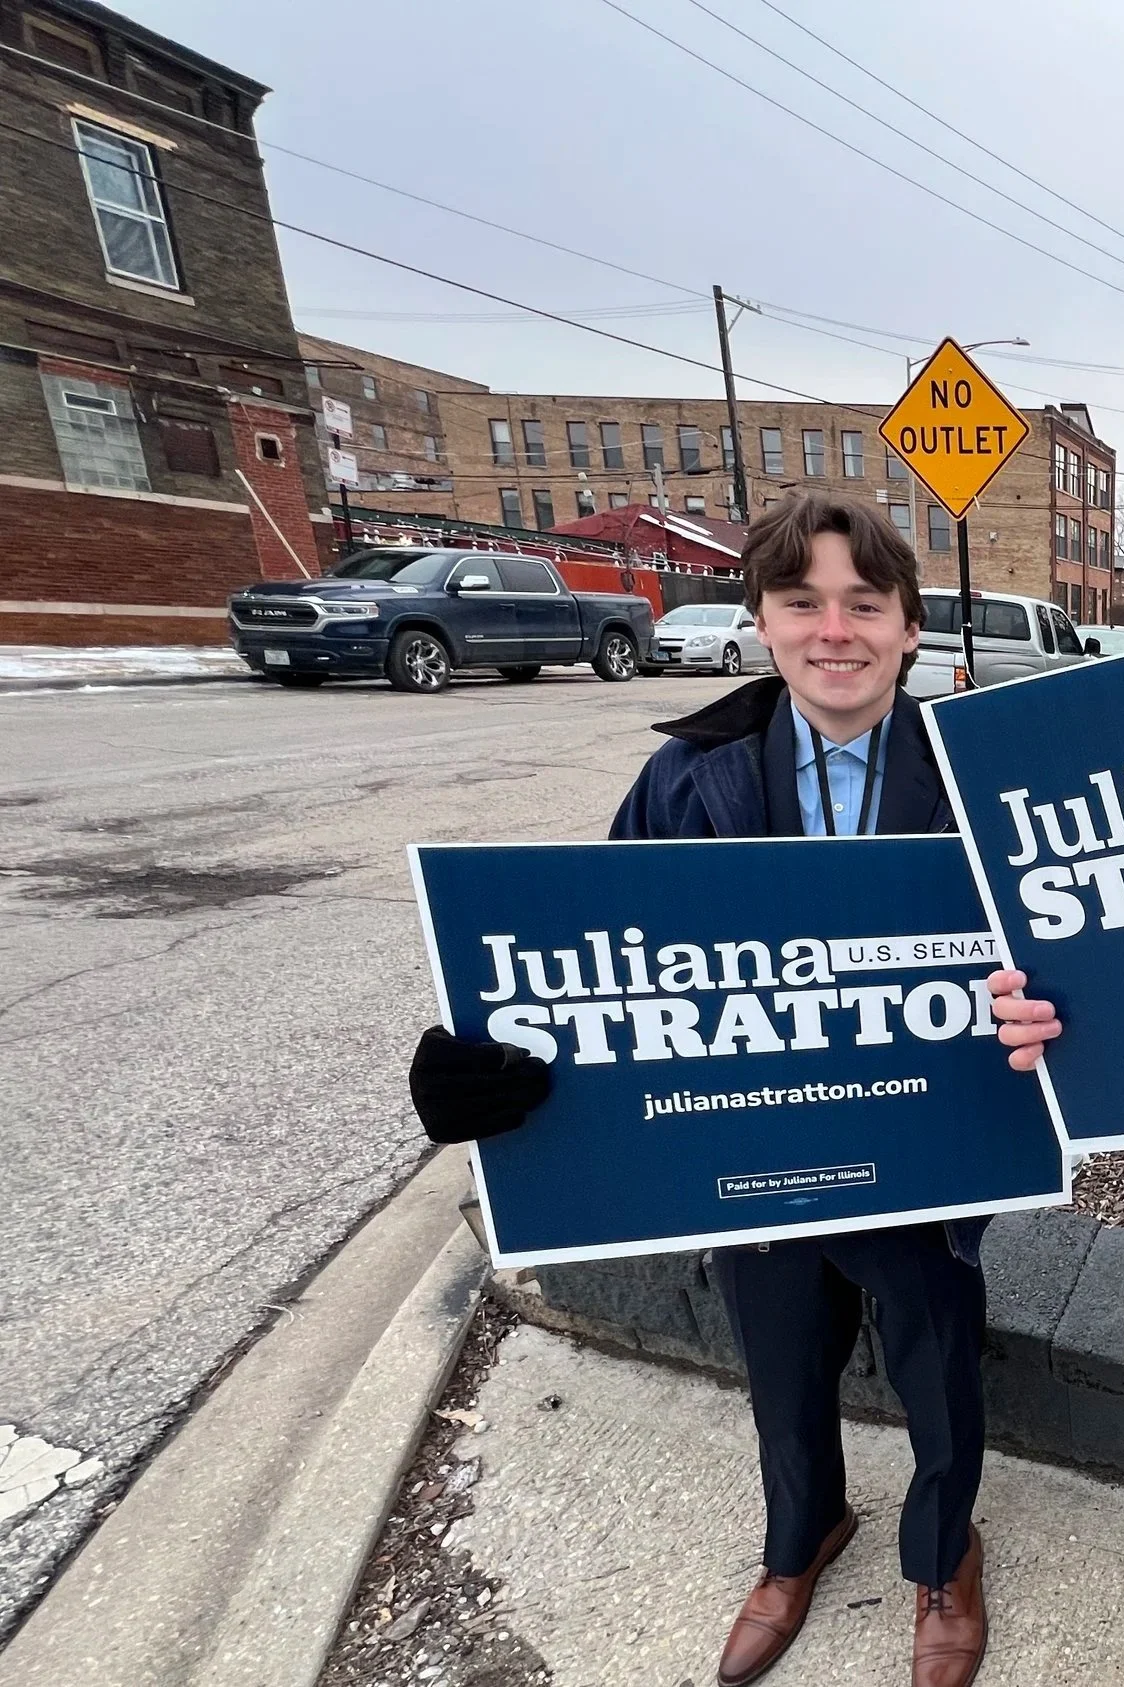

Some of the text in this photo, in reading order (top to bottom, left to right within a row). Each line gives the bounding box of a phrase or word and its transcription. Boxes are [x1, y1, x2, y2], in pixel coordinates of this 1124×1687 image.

[930, 379, 972, 409] NO
[900, 426, 1008, 455] OUTLET
[251, 608, 288, 617] RAM
[479, 927, 836, 1002] Juliana
[848, 939, 996, 963] U.S. SENAT
[644, 1077, 928, 1120] julianastratton.com
[726, 1168, 871, 1191] Paid for by Juliana For Illinois
